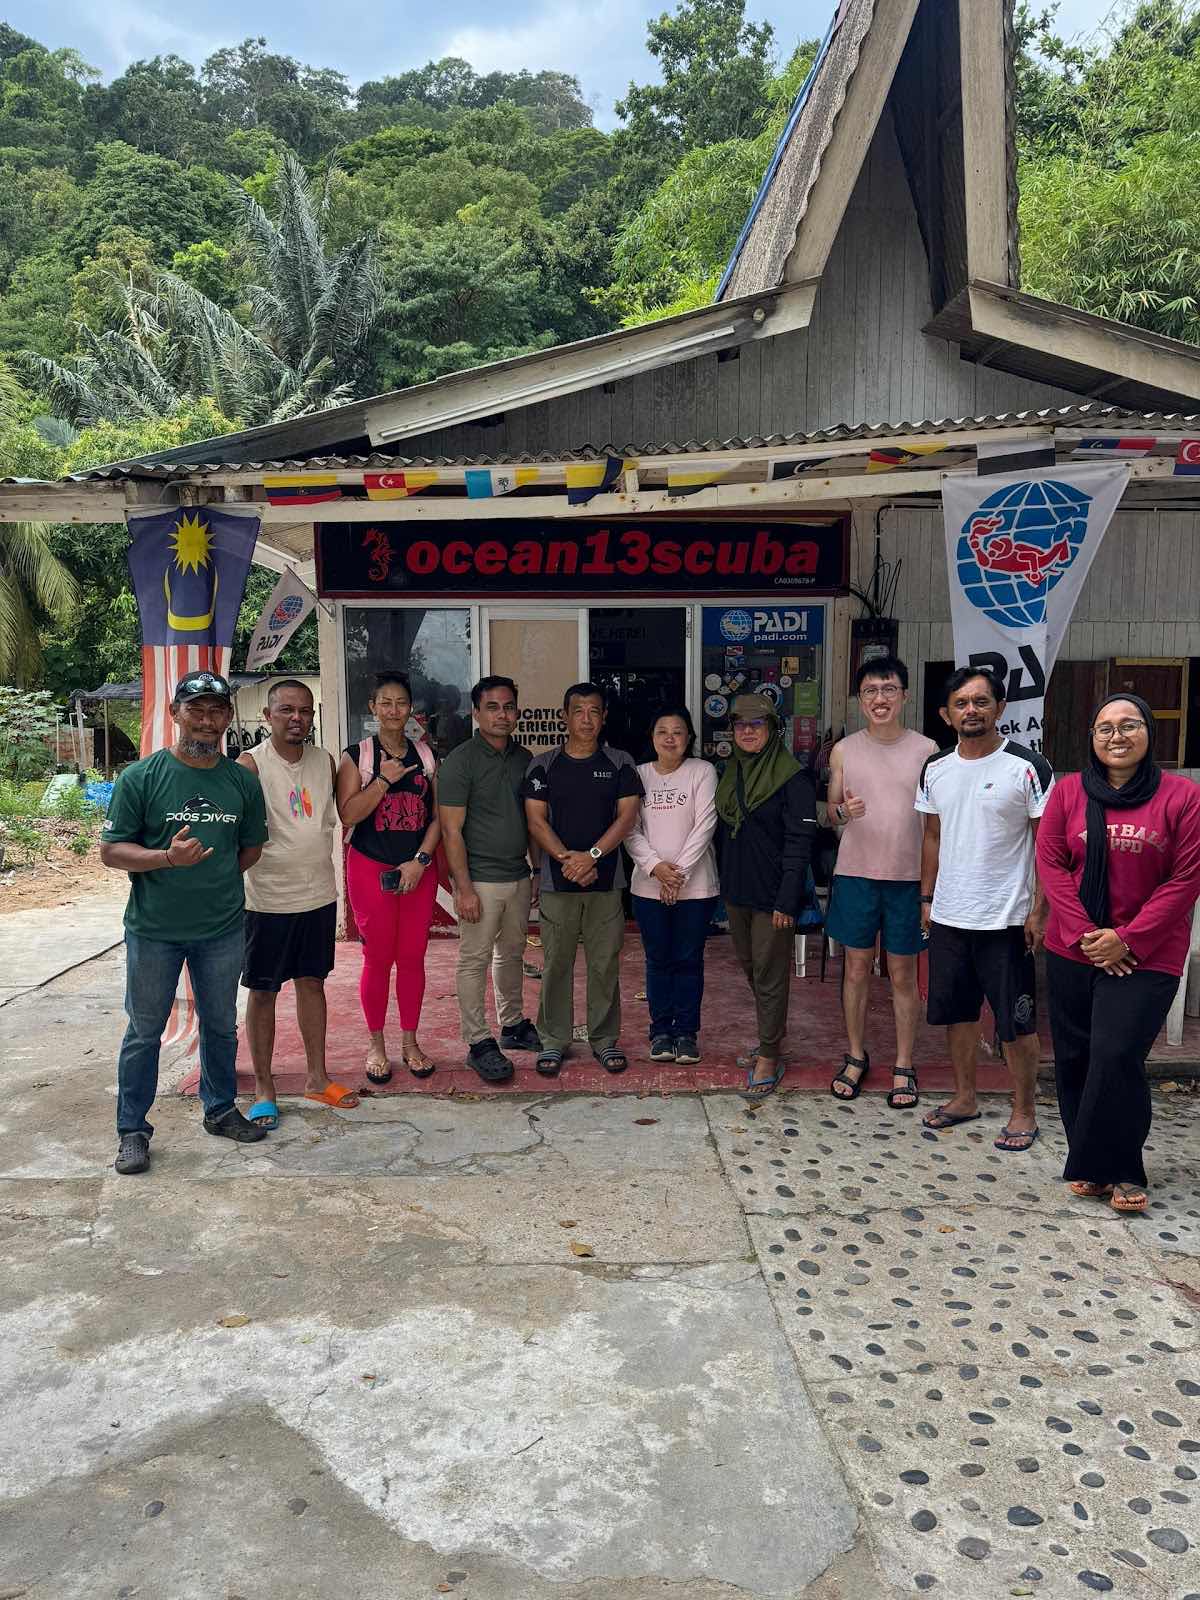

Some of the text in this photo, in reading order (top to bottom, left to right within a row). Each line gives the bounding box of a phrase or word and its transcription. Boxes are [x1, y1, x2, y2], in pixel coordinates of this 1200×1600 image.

[406, 530, 820, 575] ocean13scuba
[753, 611, 809, 632] PADI
[753, 633, 808, 642] padi.com
